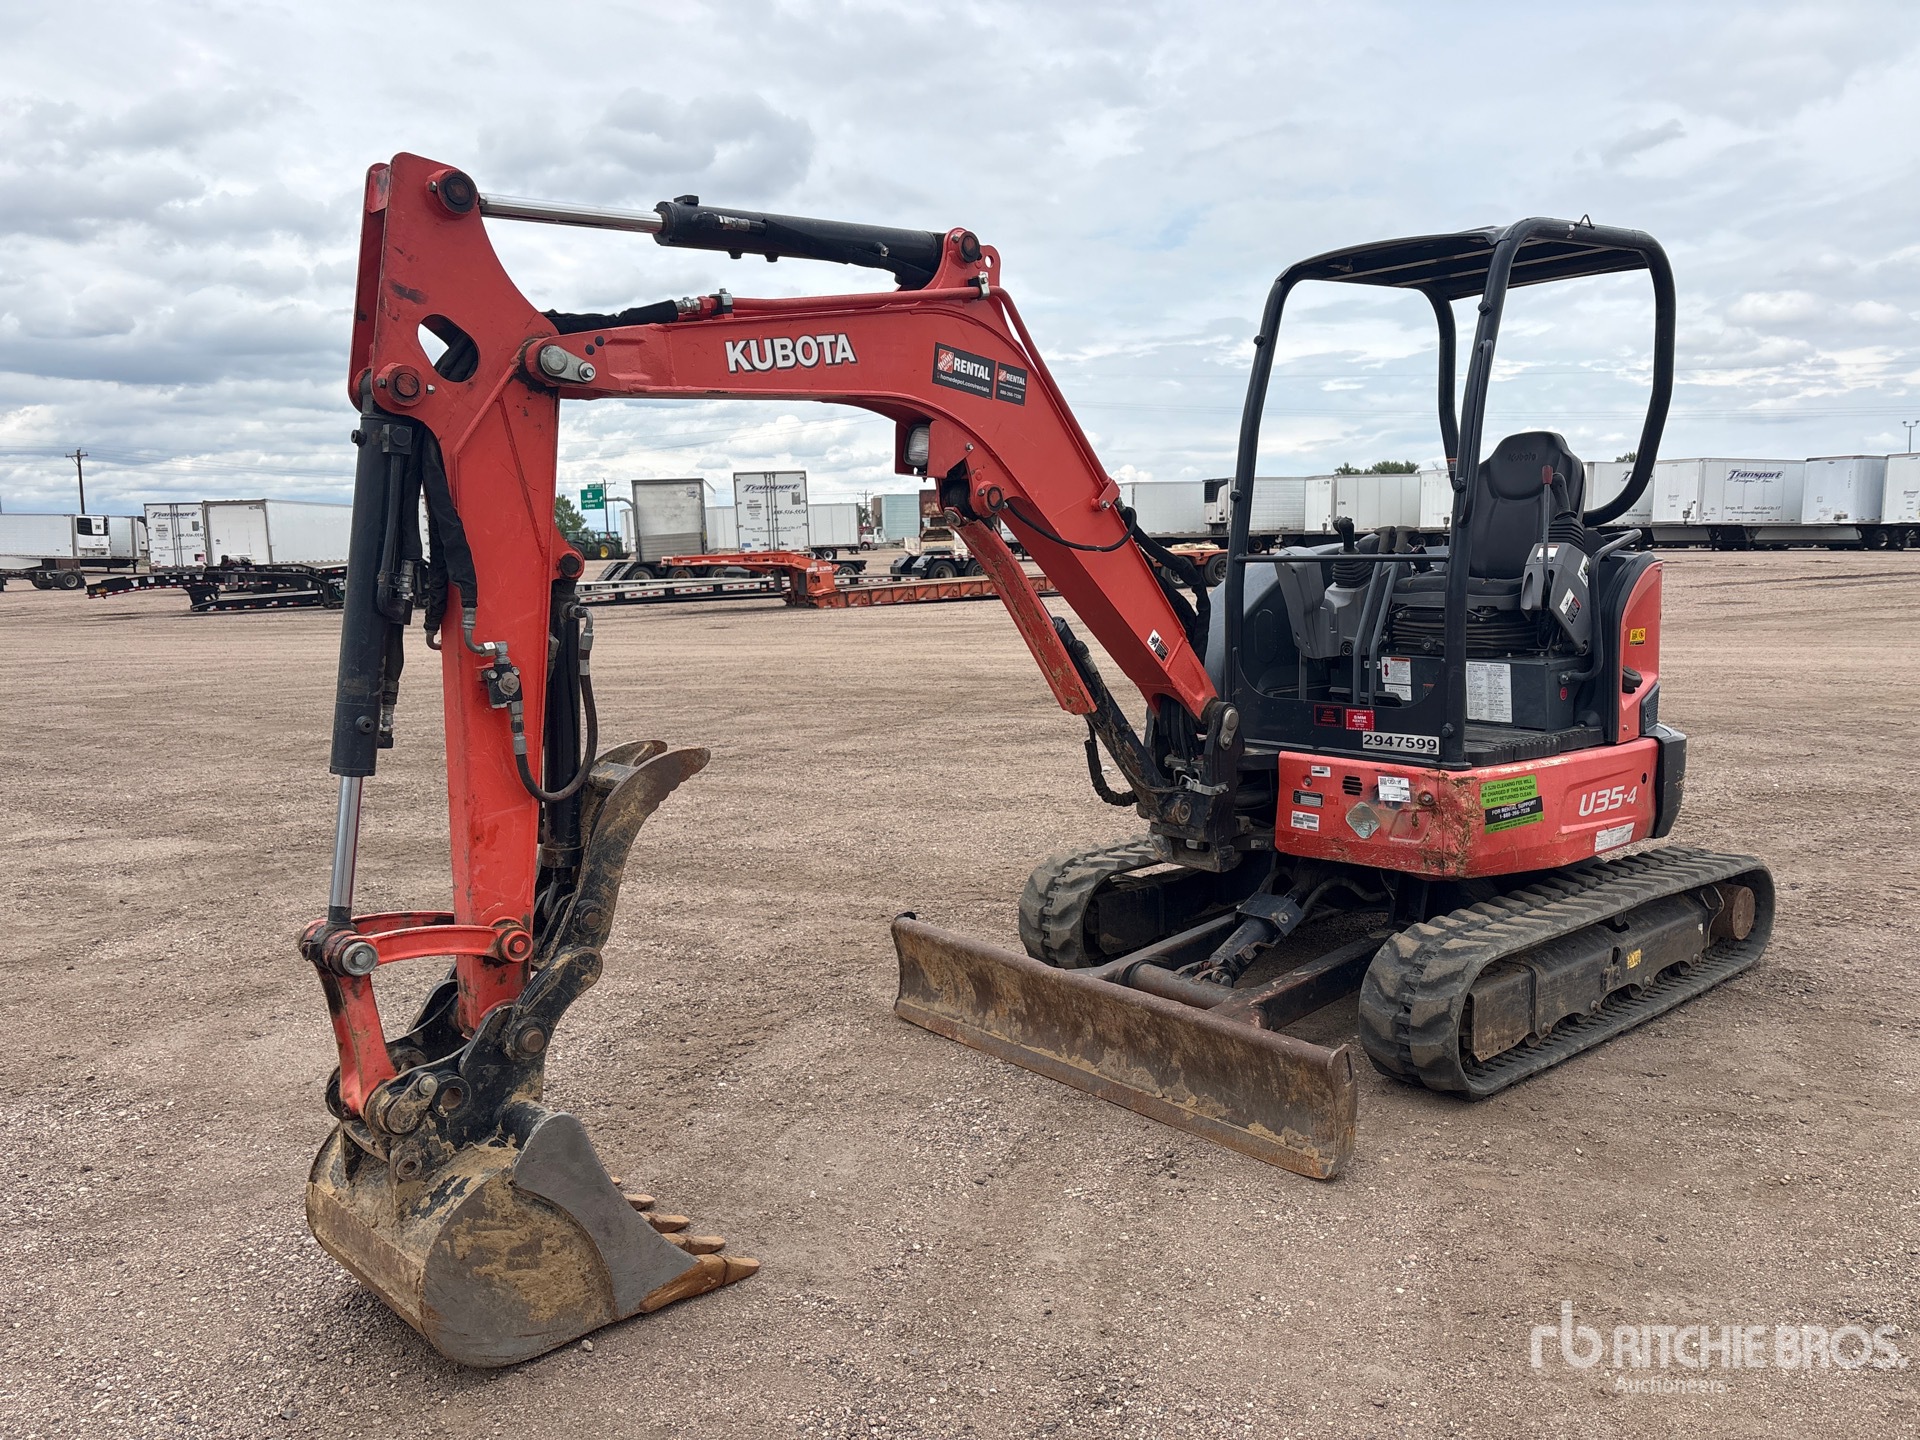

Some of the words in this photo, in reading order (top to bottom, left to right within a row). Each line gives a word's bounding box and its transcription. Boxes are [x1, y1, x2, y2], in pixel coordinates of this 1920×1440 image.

[725, 334, 857, 372] KUBOTA
[953, 357, 990, 381] RENTAL
[1006, 373, 1026, 386] RENTAL
[1726, 468, 1784, 481] Transport
[742, 483, 801, 492] Transport
[151, 511, 198, 519] Transport
[1363, 734, 1437, 750] 2947599
[1487, 789, 1506, 797] CHARGED
[1520, 784, 1536, 792] MACHINE
[1497, 781, 1516, 789] CLEANING
[1499, 794, 1519, 802] RETURNED
[1578, 785, 1638, 817] U35-4
[1491, 808, 1501, 816] FOR
[1502, 804, 1517, 814] RENTAL
[1518, 800, 1537, 809] SUPPORT
